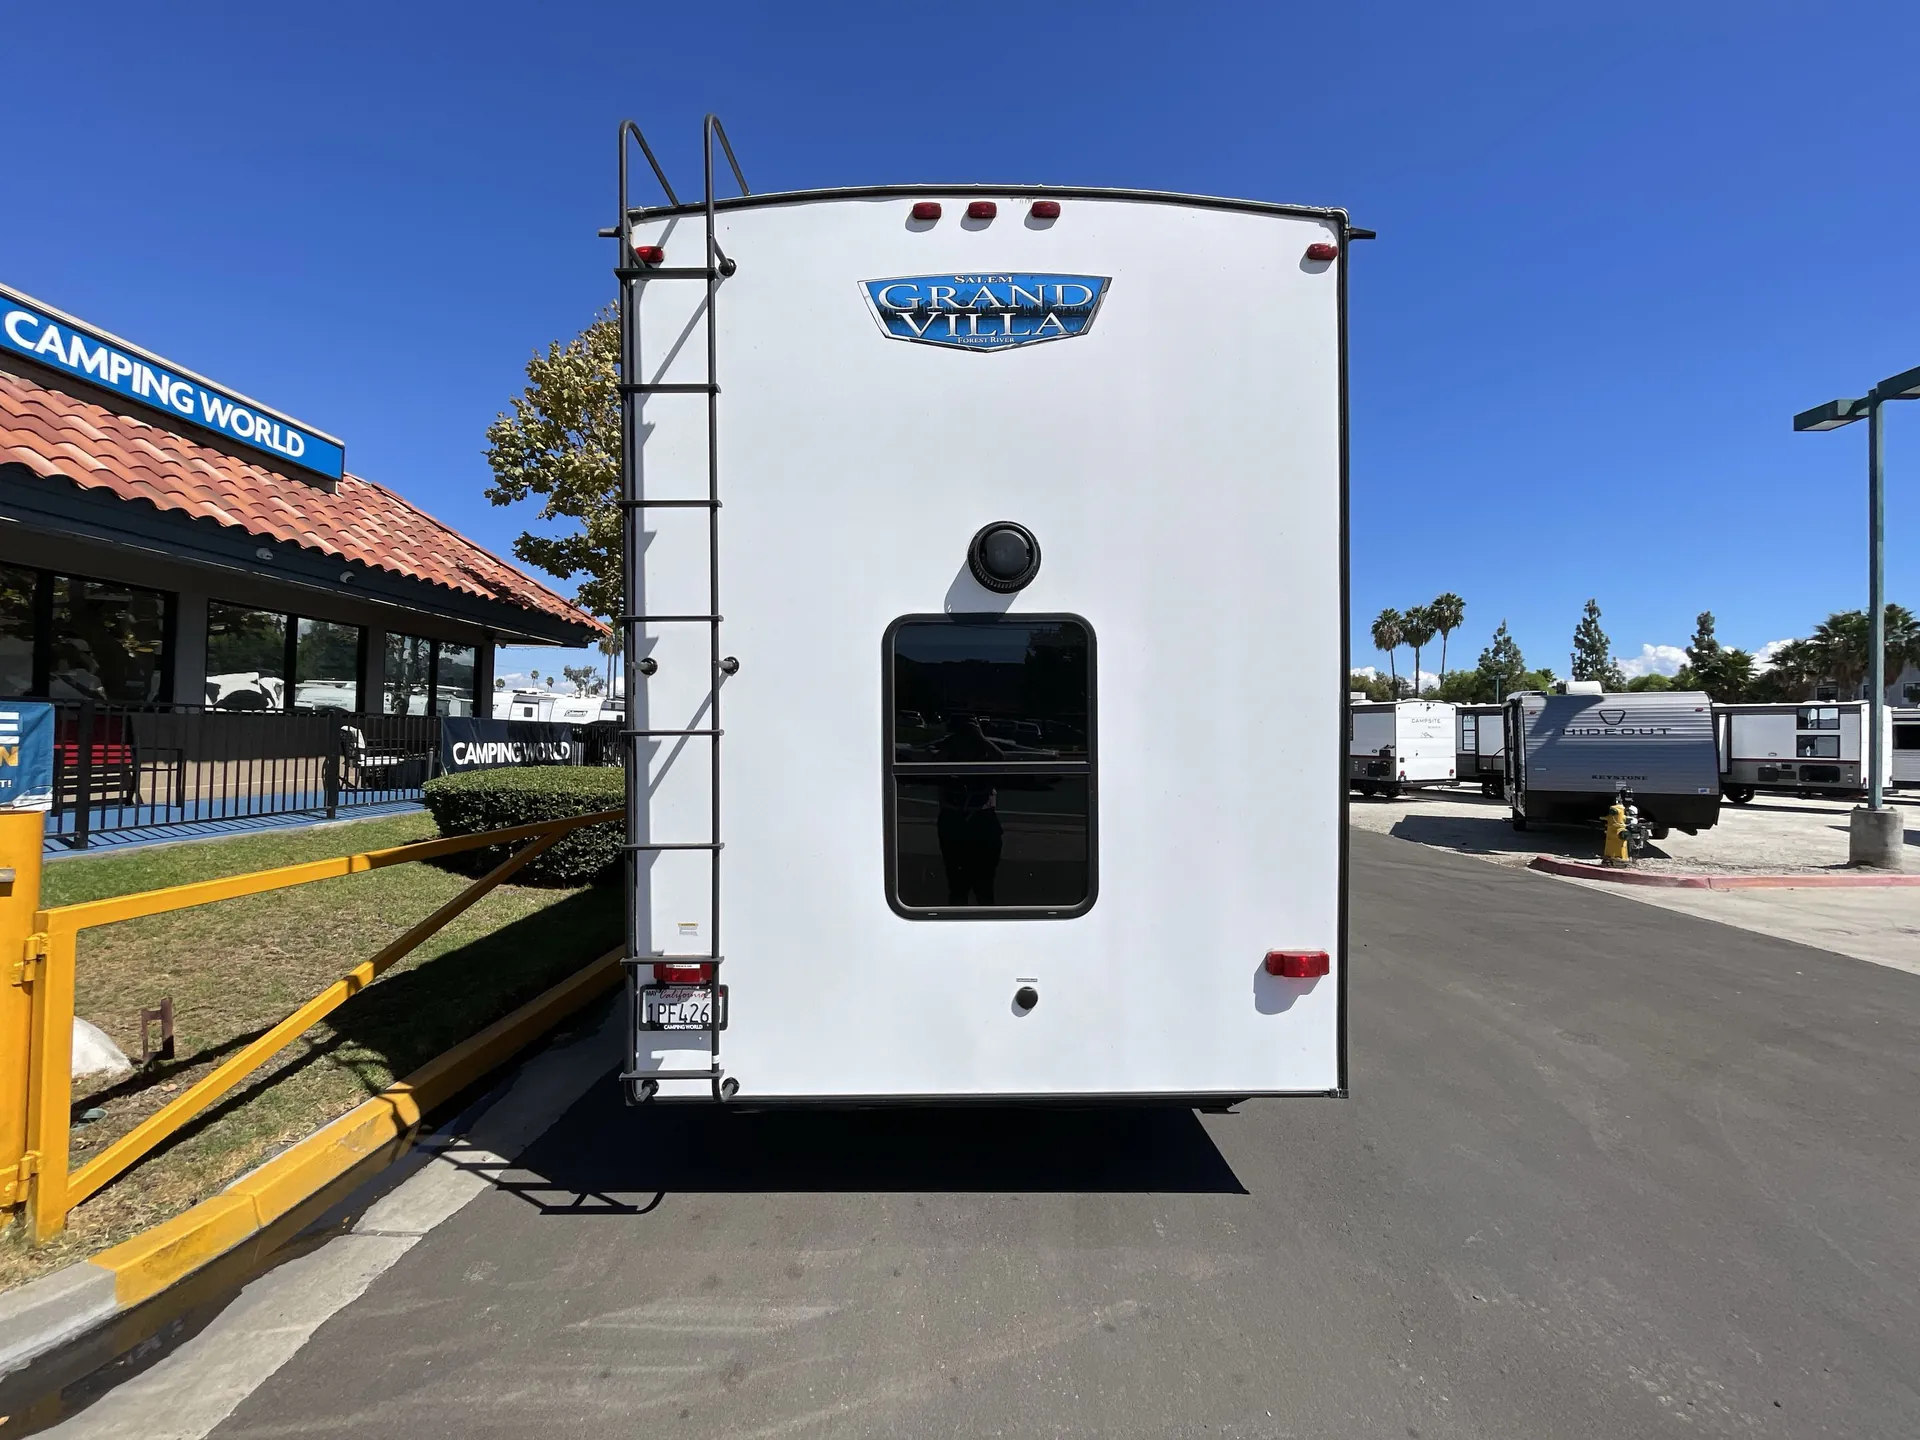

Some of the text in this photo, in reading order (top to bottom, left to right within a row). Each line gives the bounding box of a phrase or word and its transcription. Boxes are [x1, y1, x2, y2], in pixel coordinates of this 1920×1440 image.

[878, 284, 1093, 309] GRAND
[896, 311, 1071, 337] VILLA
[4, 310, 305, 458] CAMPING WORLD
[1562, 728, 1671, 736] HIDEOUT
[452, 741, 571, 765] CAMPING WORLD
[648, 1003, 717, 1023] 1PF426
